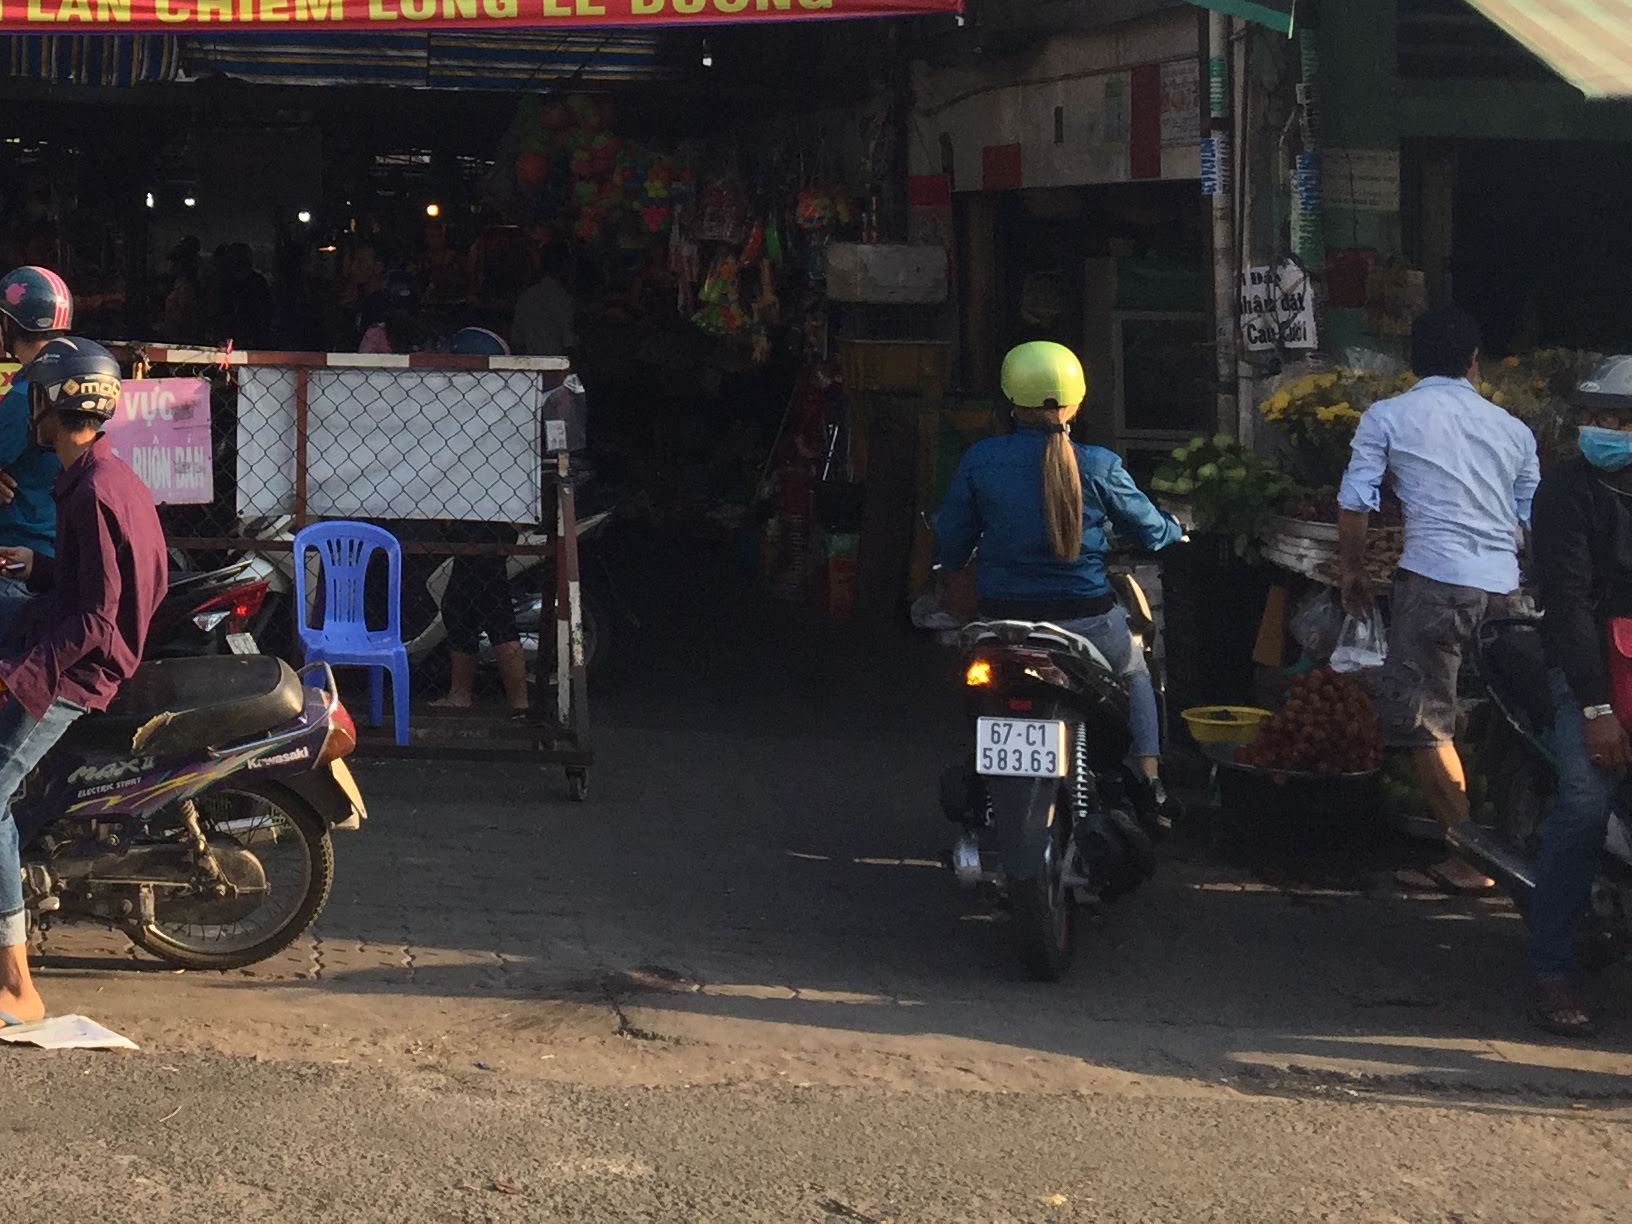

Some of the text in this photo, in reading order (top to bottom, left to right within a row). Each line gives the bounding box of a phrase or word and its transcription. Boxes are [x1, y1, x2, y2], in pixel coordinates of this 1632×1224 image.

[124, 385, 176, 427] VỰC
[991, 722, 1046, 747] 67-C1
[982, 747, 1057, 773] 583.63
